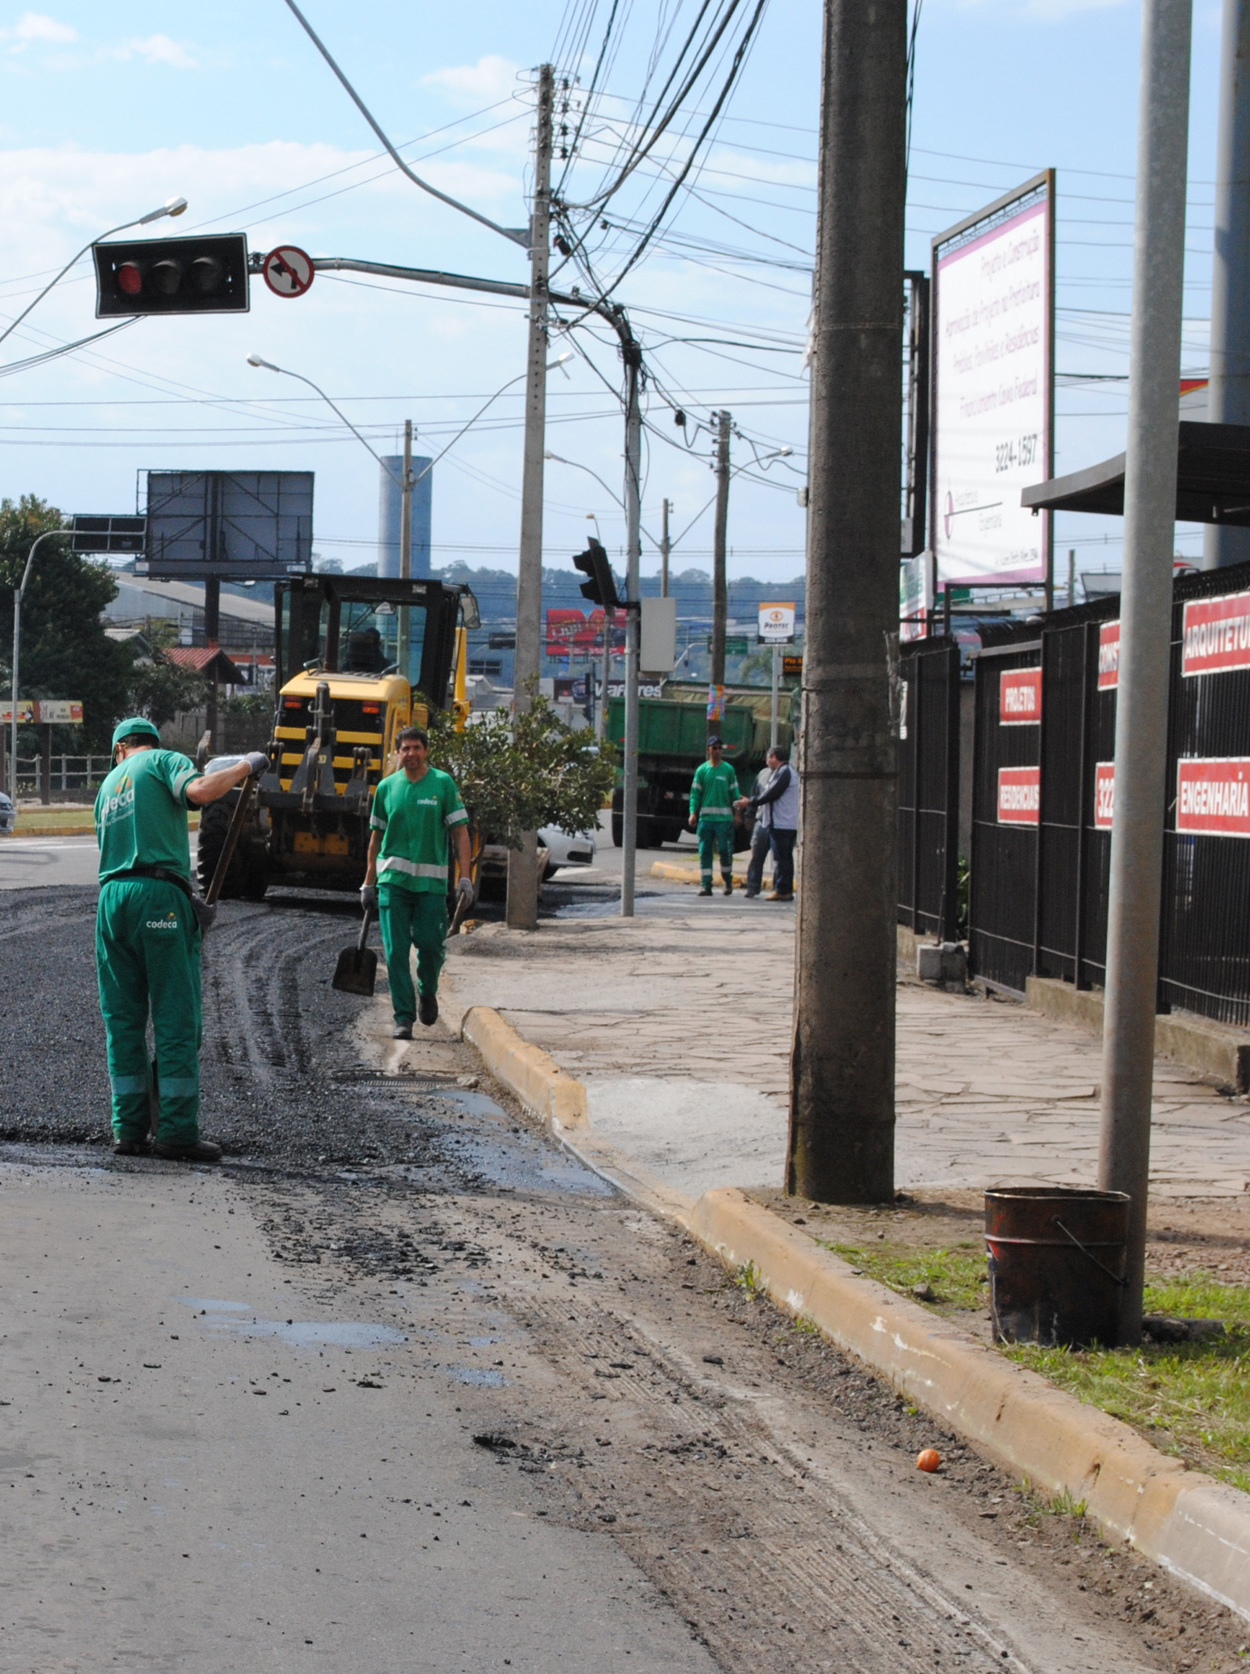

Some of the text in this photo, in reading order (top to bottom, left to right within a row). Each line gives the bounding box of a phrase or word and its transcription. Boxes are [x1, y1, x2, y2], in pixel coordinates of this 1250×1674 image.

[995, 433, 1038, 473] 3224-1597
[1005, 685, 1036, 713] PROJETOS
[145, 919, 178, 929] codeca
